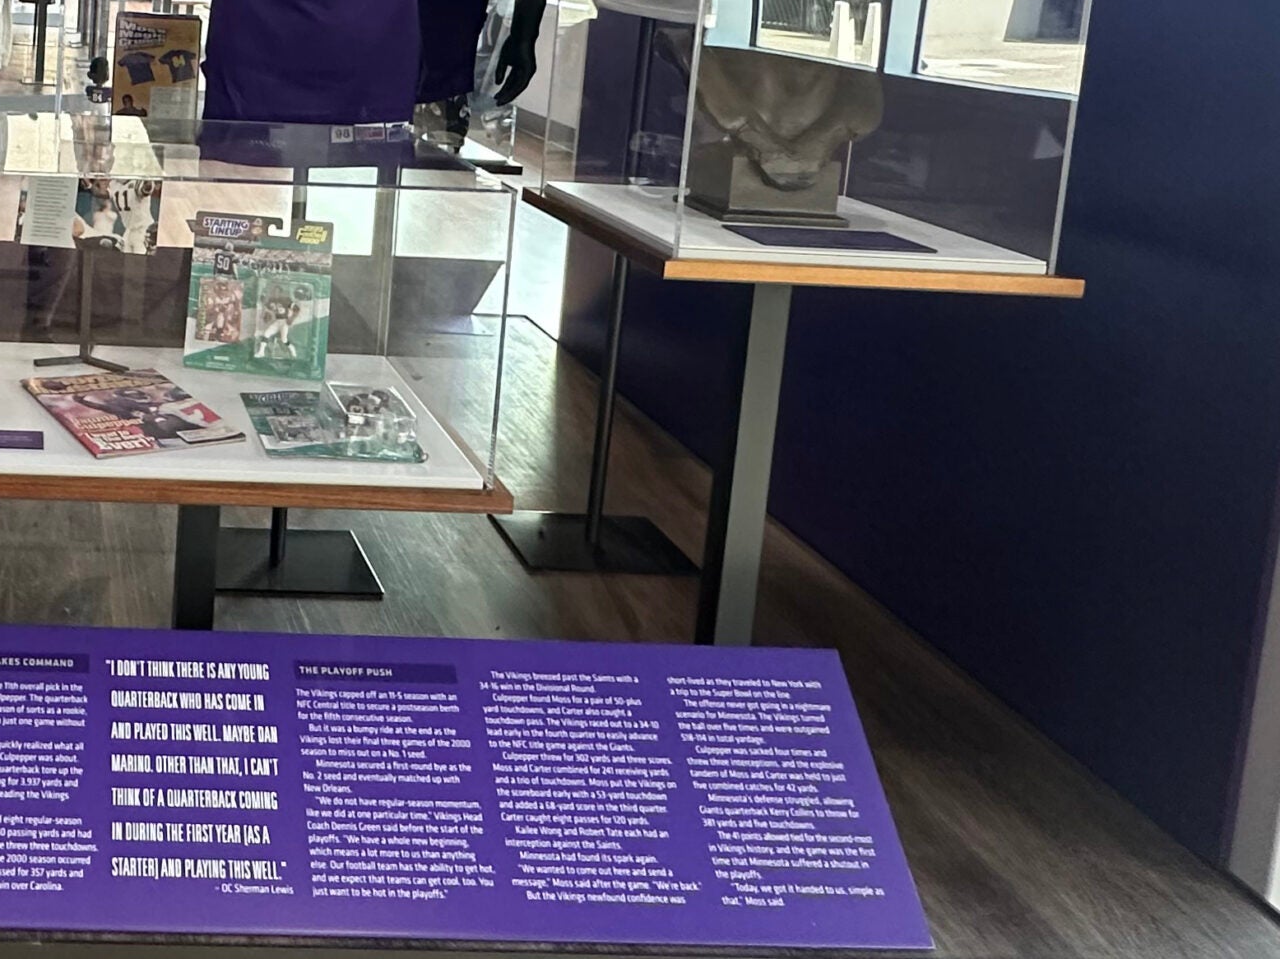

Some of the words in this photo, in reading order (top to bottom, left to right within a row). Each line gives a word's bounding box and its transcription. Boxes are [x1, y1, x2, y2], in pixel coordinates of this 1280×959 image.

[113, 189, 131, 212] 11
[203, 216, 250, 231] STARTING
[209, 226, 242, 237] LINEUP
[215, 255, 231, 271] 50
[22, 657, 74, 668] COMMAND
[117, 659, 145, 677] DON'T
[147, 660, 175, 678] THINK
[175, 661, 205, 679] THERE
[206, 662, 216, 679] IS
[217, 662, 236, 679] ANY
[237, 663, 270, 680] YOUNG
[298, 665, 318, 674] THE
[320, 666, 363, 676] PLAYOFF
[366, 668, 393, 676] PUSH
[111, 689, 179, 709] QUARTERBACK
[179, 692, 202, 710] WHO
[203, 692, 224, 710] HAS
[225, 693, 252, 711] COME
[253, 694, 265, 711] IN
[110, 721, 131, 739] AND
[133, 722, 168, 741] PLAYED
[170, 723, 192, 741] THIS
[192, 724, 222, 742] WELL.
[222, 724, 256, 743] MAYBE
[257, 725, 278, 743] DAN
[111, 754, 154, 773] MARINO.
[155, 755, 187, 774] OTHER
[188, 755, 215, 774] THAN
[243, 757, 249, 775] I
[250, 757, 278, 776] CAN'T
[111, 787, 141, 806] THINK
[142, 788, 155, 807] OF
[156, 788, 165, 807] A
[166, 788, 238, 809] QUARTERBACK
[238, 790, 278, 810] COMING
[111, 821, 123, 841] IN
[125, 822, 164, 842] DURING
[165, 822, 184, 842] THE
[186, 823, 214, 843] FIRST
[214, 824, 241, 844] YEAR
[243, 824, 261, 846] [AS
[262, 825, 271, 844] A
[111, 856, 159, 880] STARTER]
[160, 858, 182, 878] AND
[184, 858, 226, 879] PLAYING
[227, 859, 251, 880] THIS
[221, 883, 233, 893] OC
[233, 883, 270, 894] Sherman
[270, 884, 294, 894] Lewis
